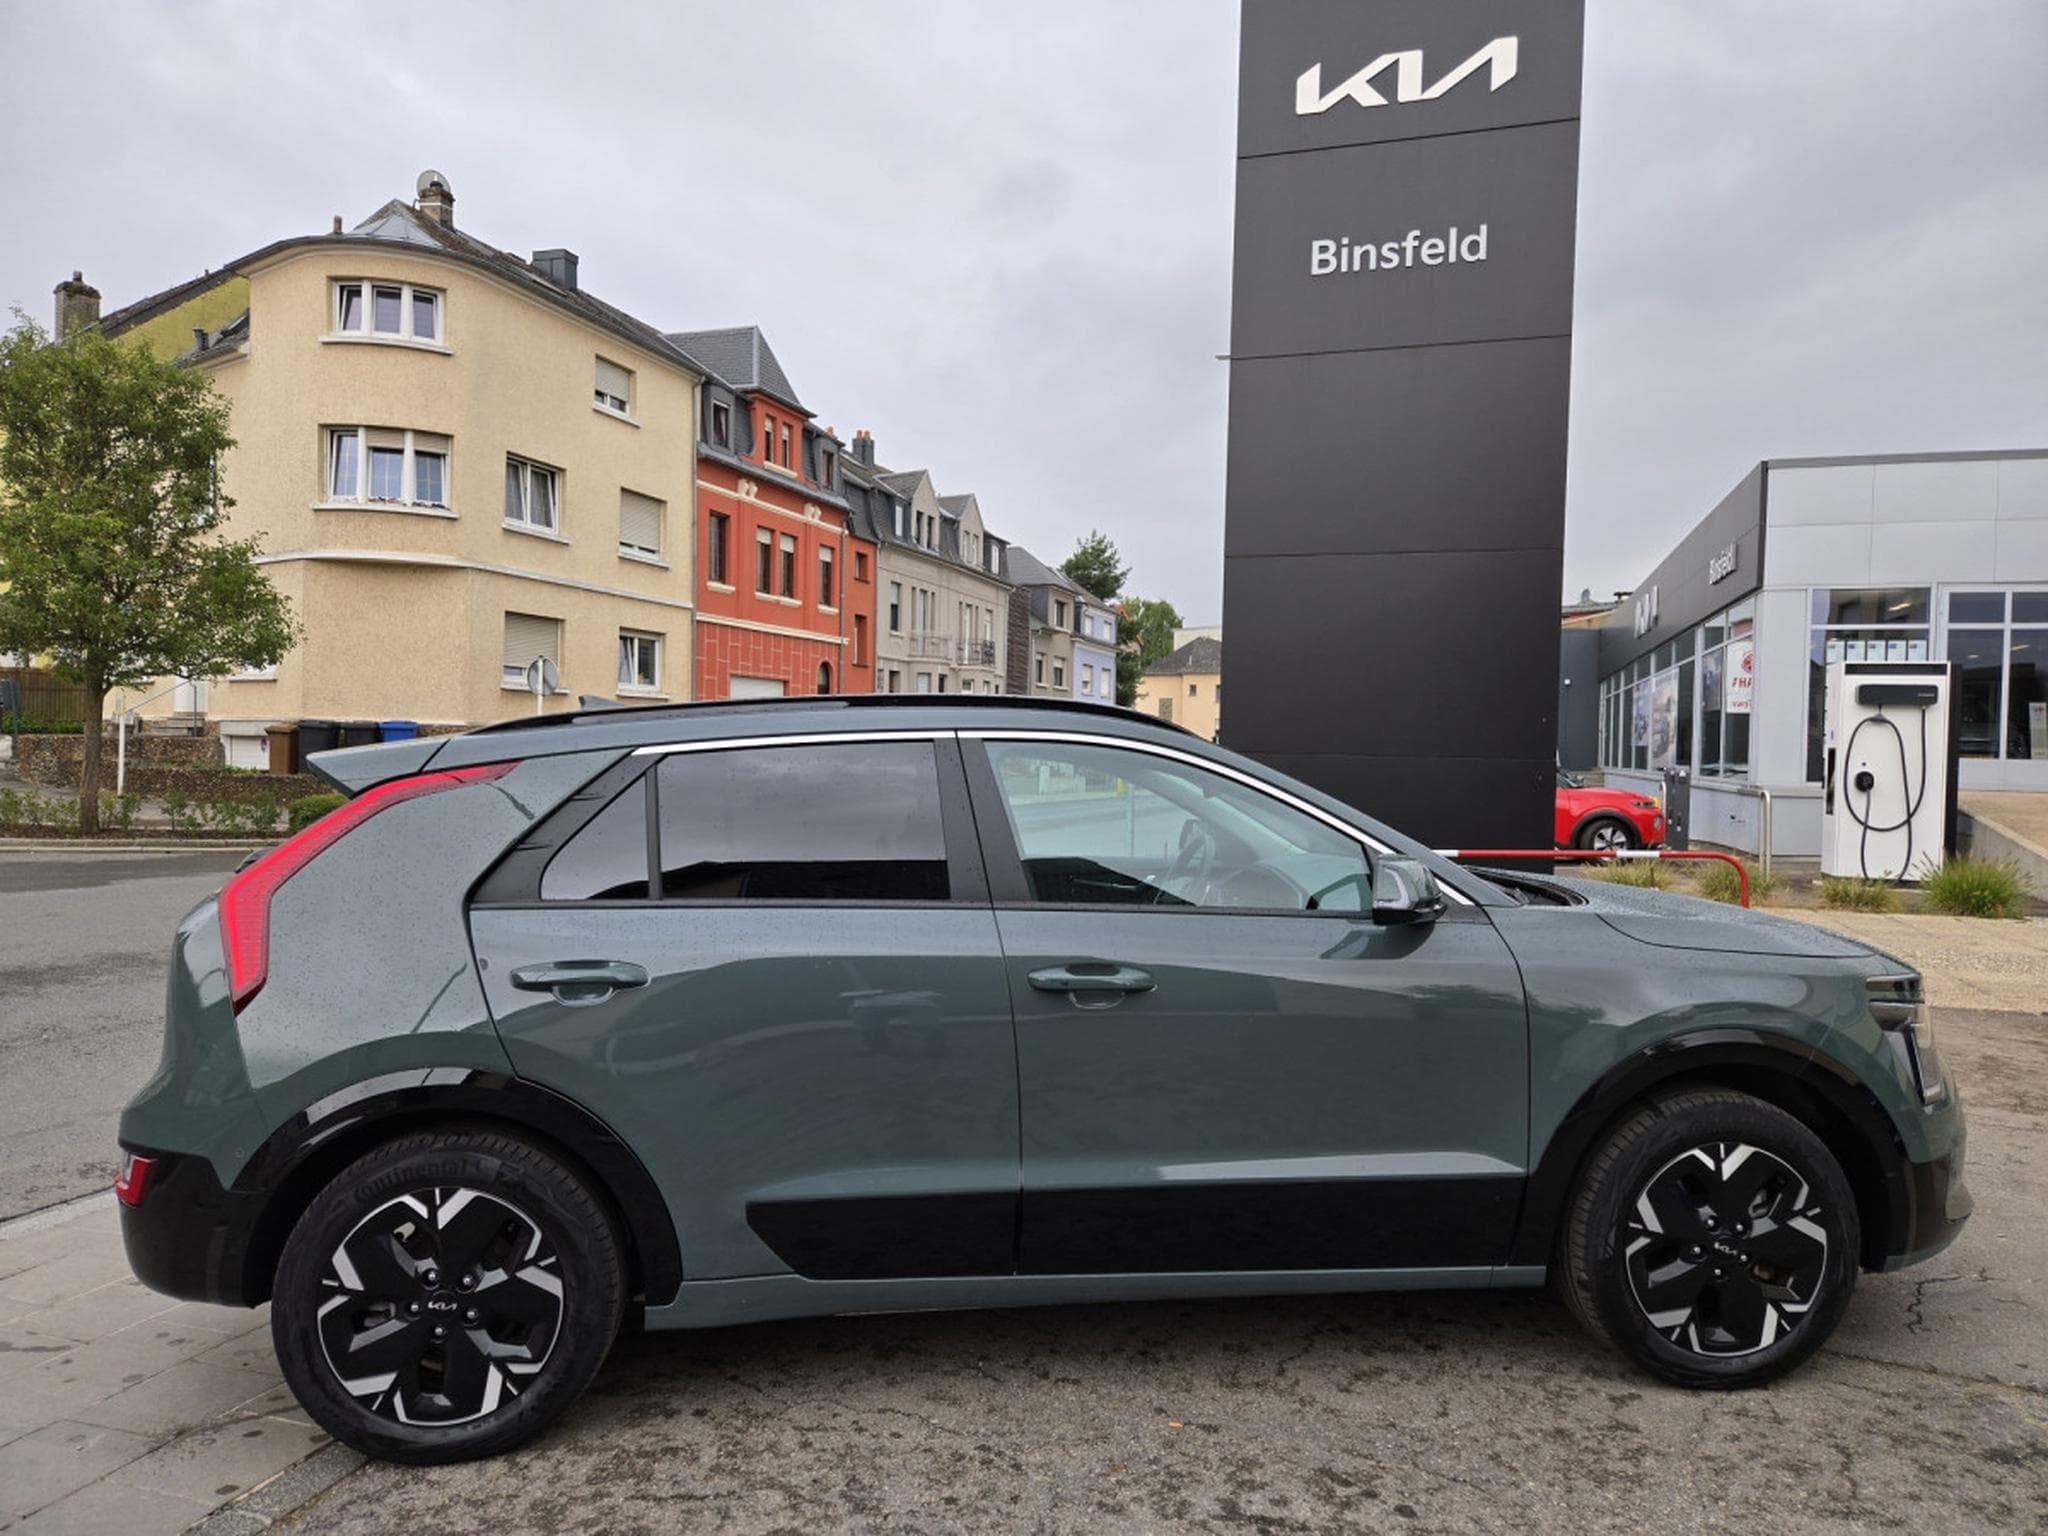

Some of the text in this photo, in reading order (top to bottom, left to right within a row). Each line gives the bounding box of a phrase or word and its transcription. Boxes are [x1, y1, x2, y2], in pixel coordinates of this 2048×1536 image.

[1296, 36, 1518, 115] KIA
[1311, 224, 1488, 276] Binsfeld
[428, 1301, 457, 1311] KIA
